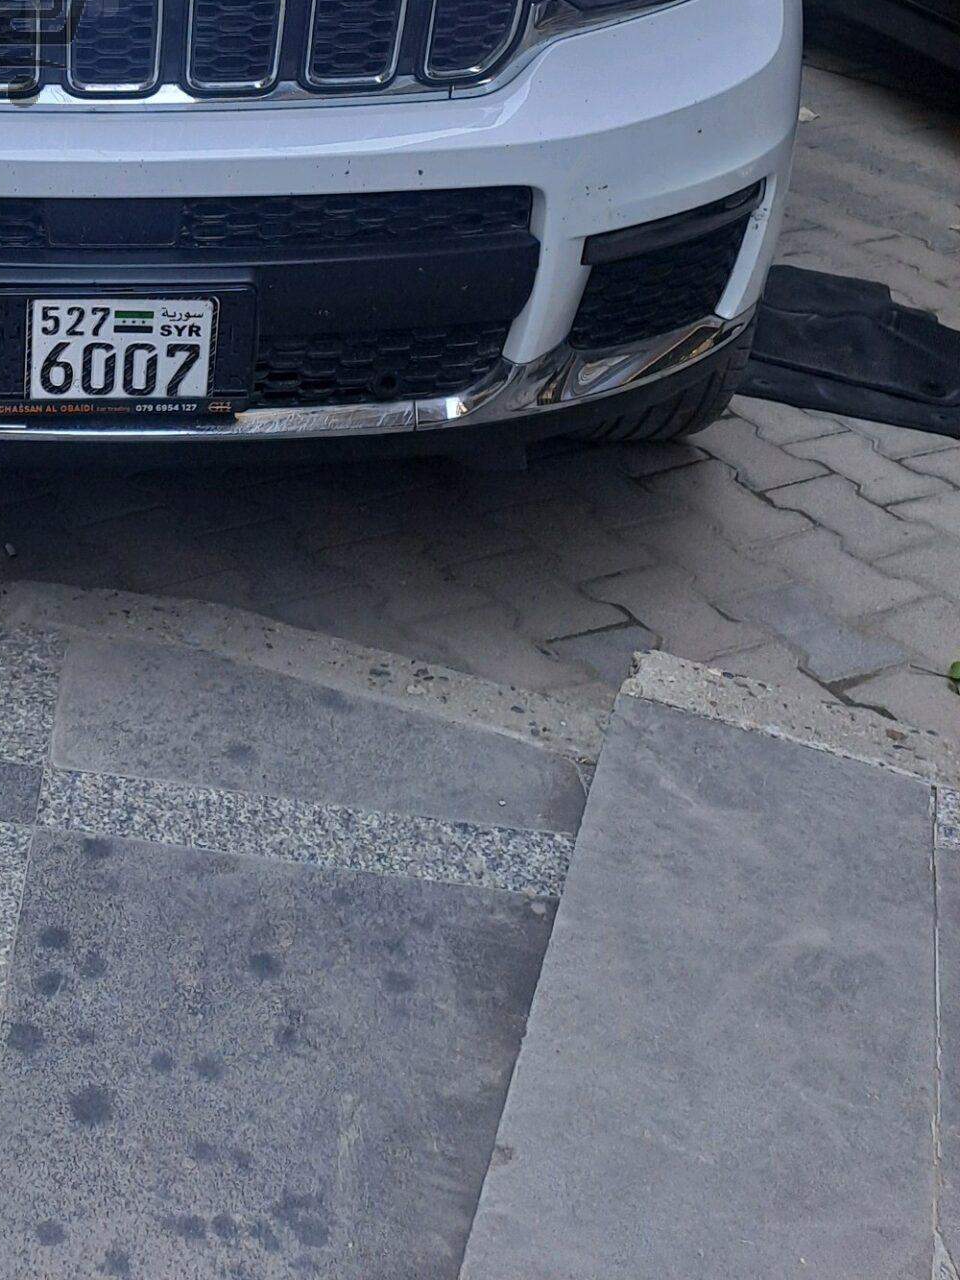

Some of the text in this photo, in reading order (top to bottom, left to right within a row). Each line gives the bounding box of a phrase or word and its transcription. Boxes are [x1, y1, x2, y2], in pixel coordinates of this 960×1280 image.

[161, 307, 204, 320] سورية
[41, 306, 111, 337] 527
[160, 324, 202, 338] SYR
[40, 341, 201, 397] 6007
[45, 404, 58, 413] AL
[60, 404, 94, 413] OBAIDI
[136, 404, 154, 412] 079
[155, 403, 179, 412] 6954
[181, 403, 198, 411] 127
